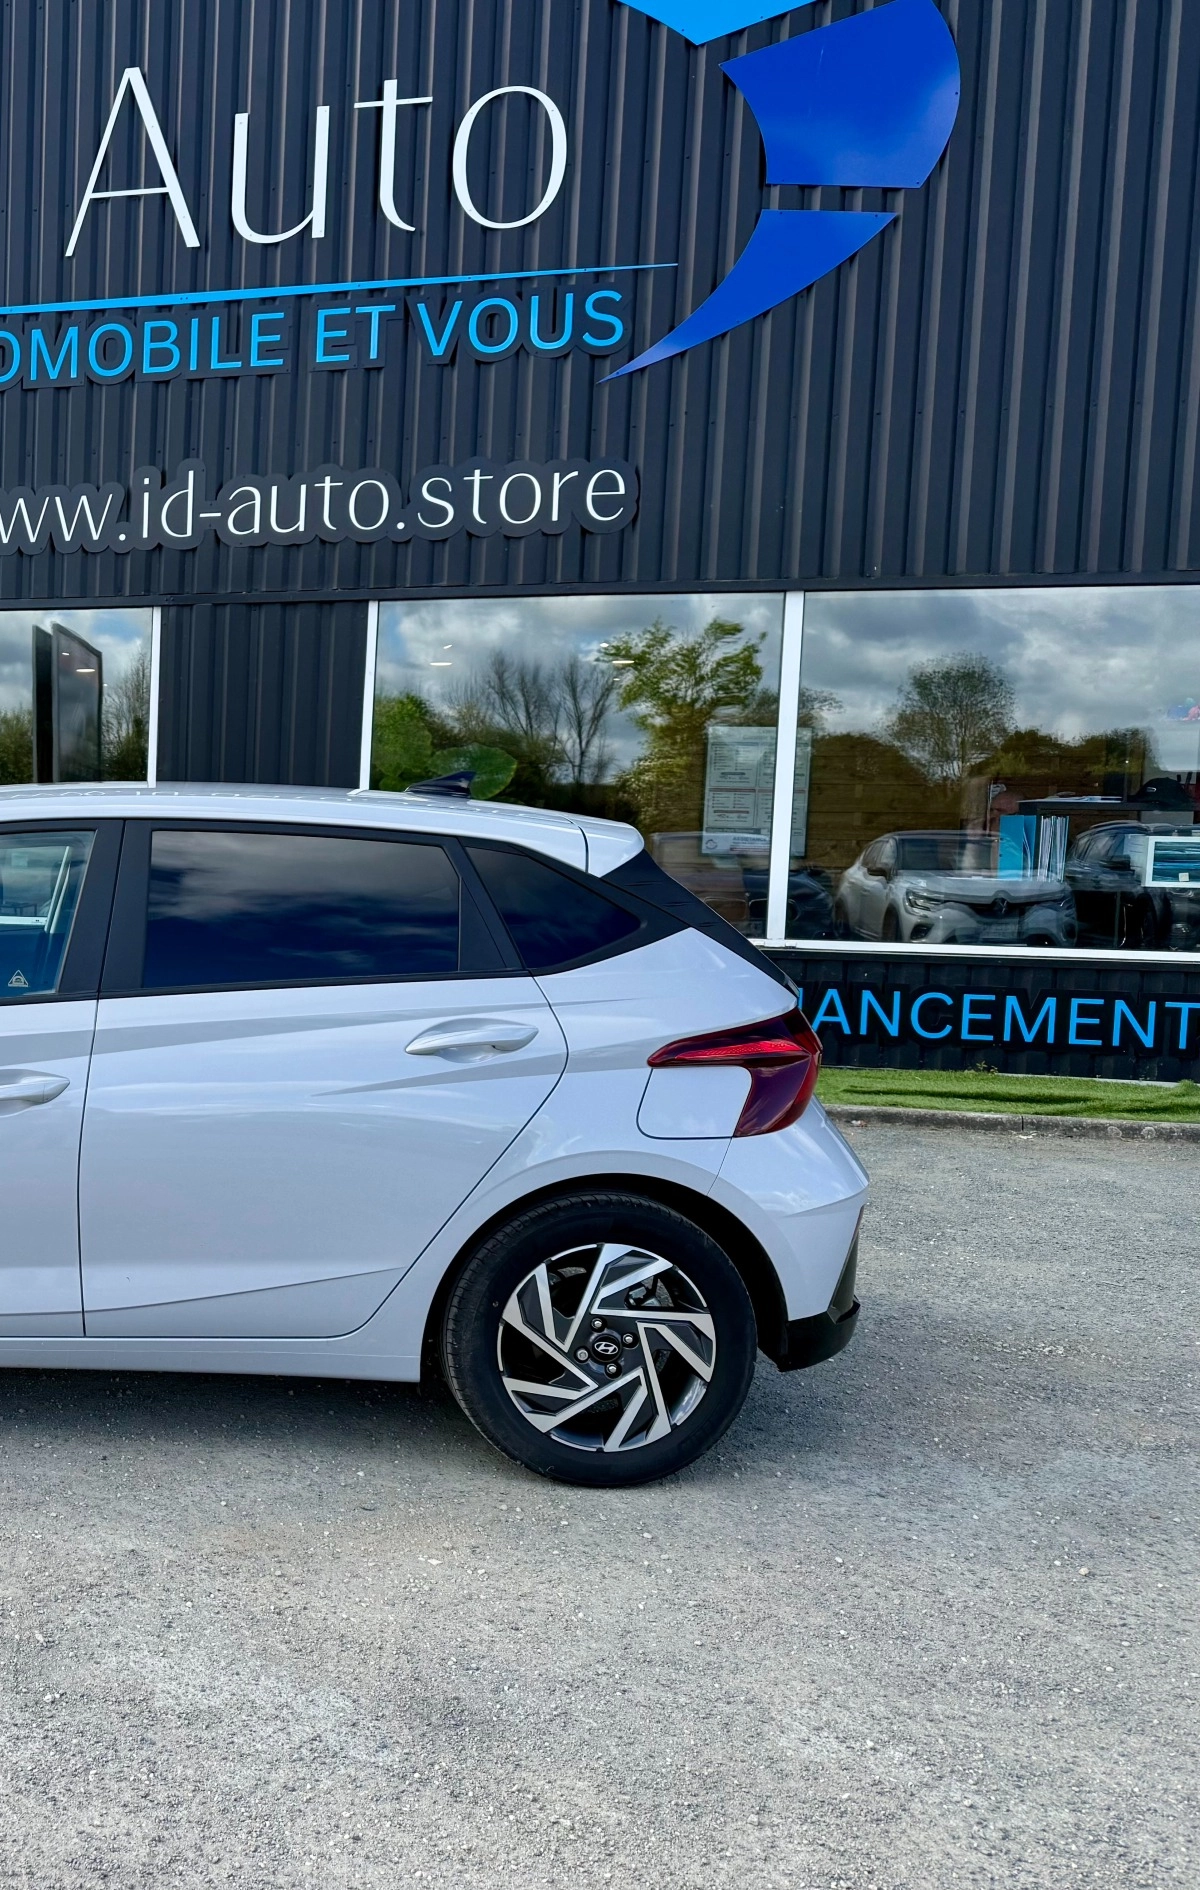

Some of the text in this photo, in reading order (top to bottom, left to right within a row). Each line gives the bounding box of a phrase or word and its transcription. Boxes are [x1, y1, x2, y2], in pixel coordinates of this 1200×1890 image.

[65, 66, 567, 257] Auto
[315, 304, 397, 363] ET
[416, 290, 625, 357] VOUS
[798, 987, 1200, 1050] ANCEMENT
